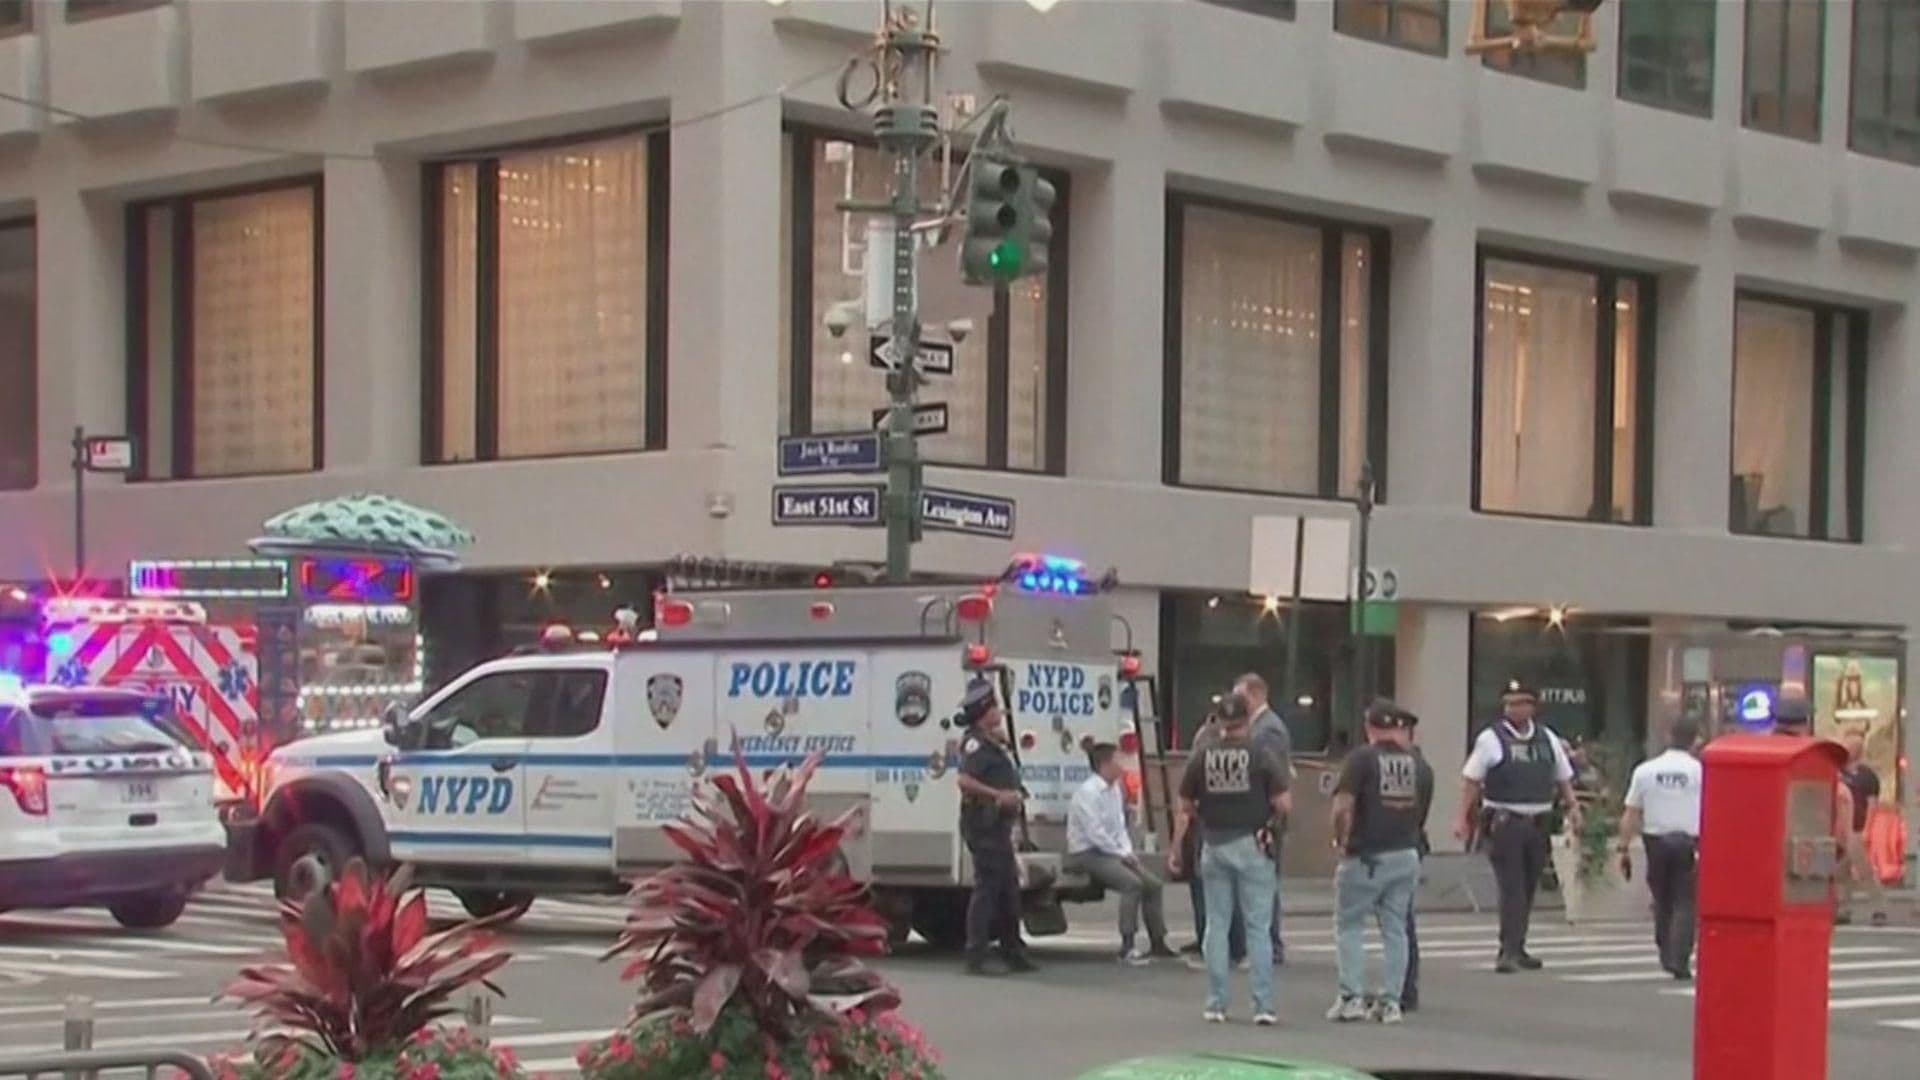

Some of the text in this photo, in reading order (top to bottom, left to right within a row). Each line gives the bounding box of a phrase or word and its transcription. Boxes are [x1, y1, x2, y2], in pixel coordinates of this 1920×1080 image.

[783, 496, 869, 516] East 51st St
[923, 499, 1008, 529] Lexington Ave
[728, 661, 855, 697] POLICE
[1028, 664, 1084, 689] NYPD
[1018, 690, 1094, 715] POLICE
[417, 776, 514, 815] NYPD
